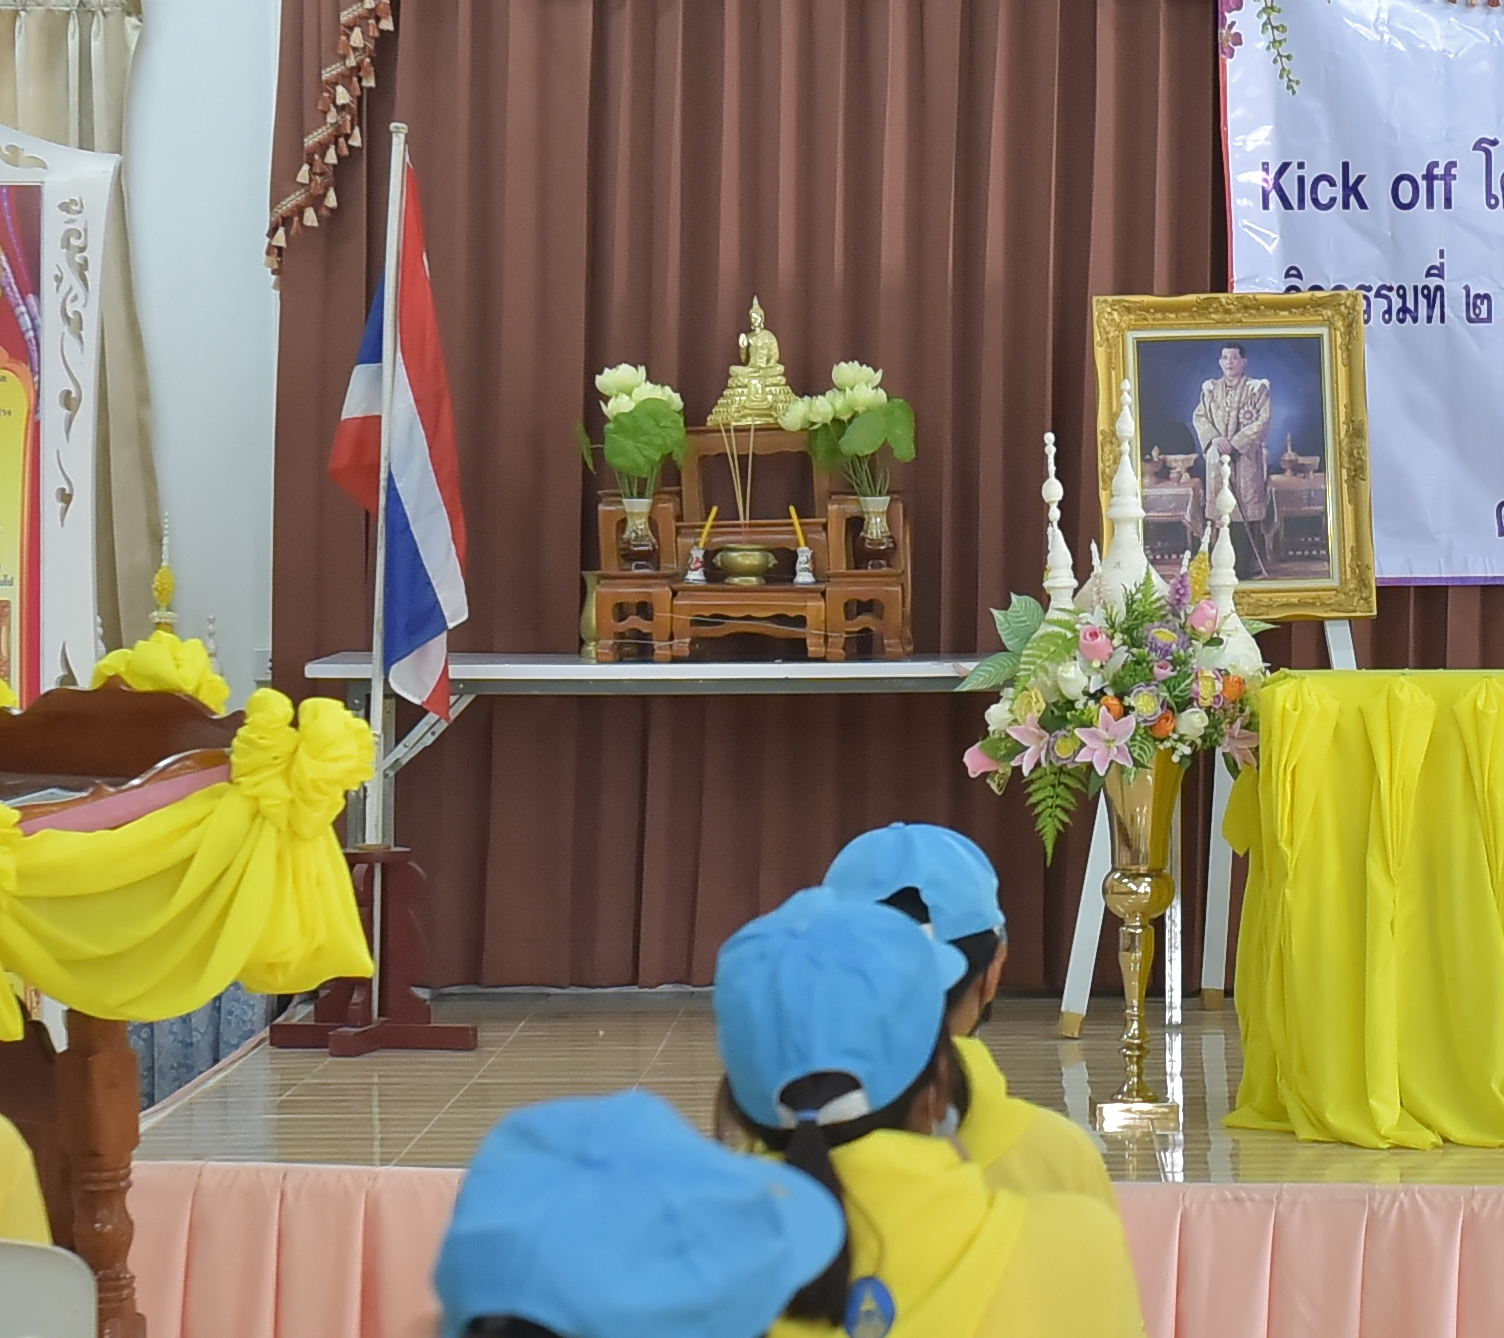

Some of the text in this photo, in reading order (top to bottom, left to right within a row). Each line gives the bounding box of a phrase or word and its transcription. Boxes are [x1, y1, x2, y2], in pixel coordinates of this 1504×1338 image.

[1260, 160, 1368, 211] Kick
[1390, 160, 1458, 211] off
[1462, 283, 1494, 325] ๒
